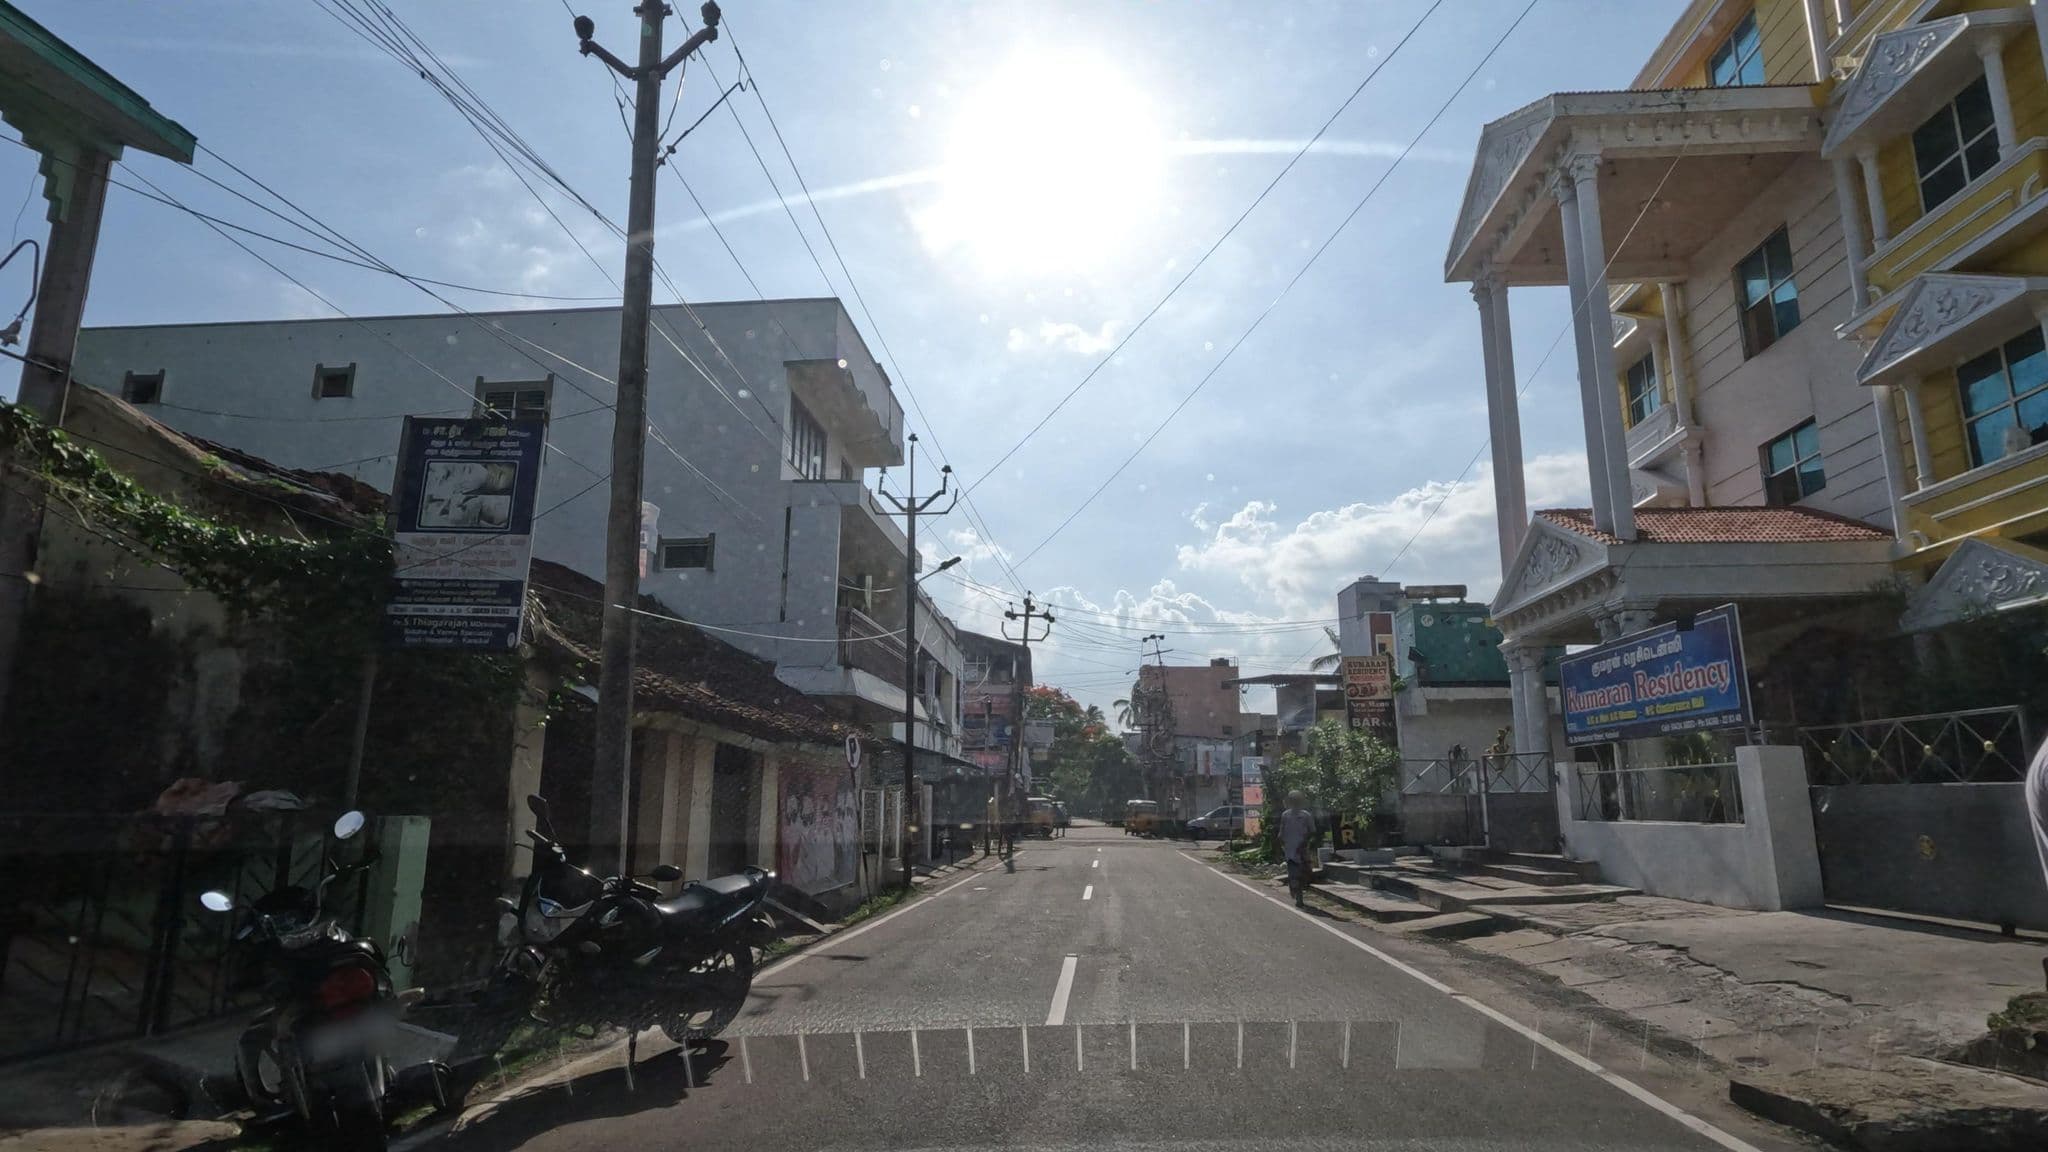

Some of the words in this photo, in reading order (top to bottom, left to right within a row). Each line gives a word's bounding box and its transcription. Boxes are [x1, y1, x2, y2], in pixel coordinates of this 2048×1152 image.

[412, 616, 467, 629] Thiagarajan
[1566, 682, 1632, 713] Kumaran
[1633, 660, 1730, 701] Residency
[1352, 717, 1380, 727] BAR
